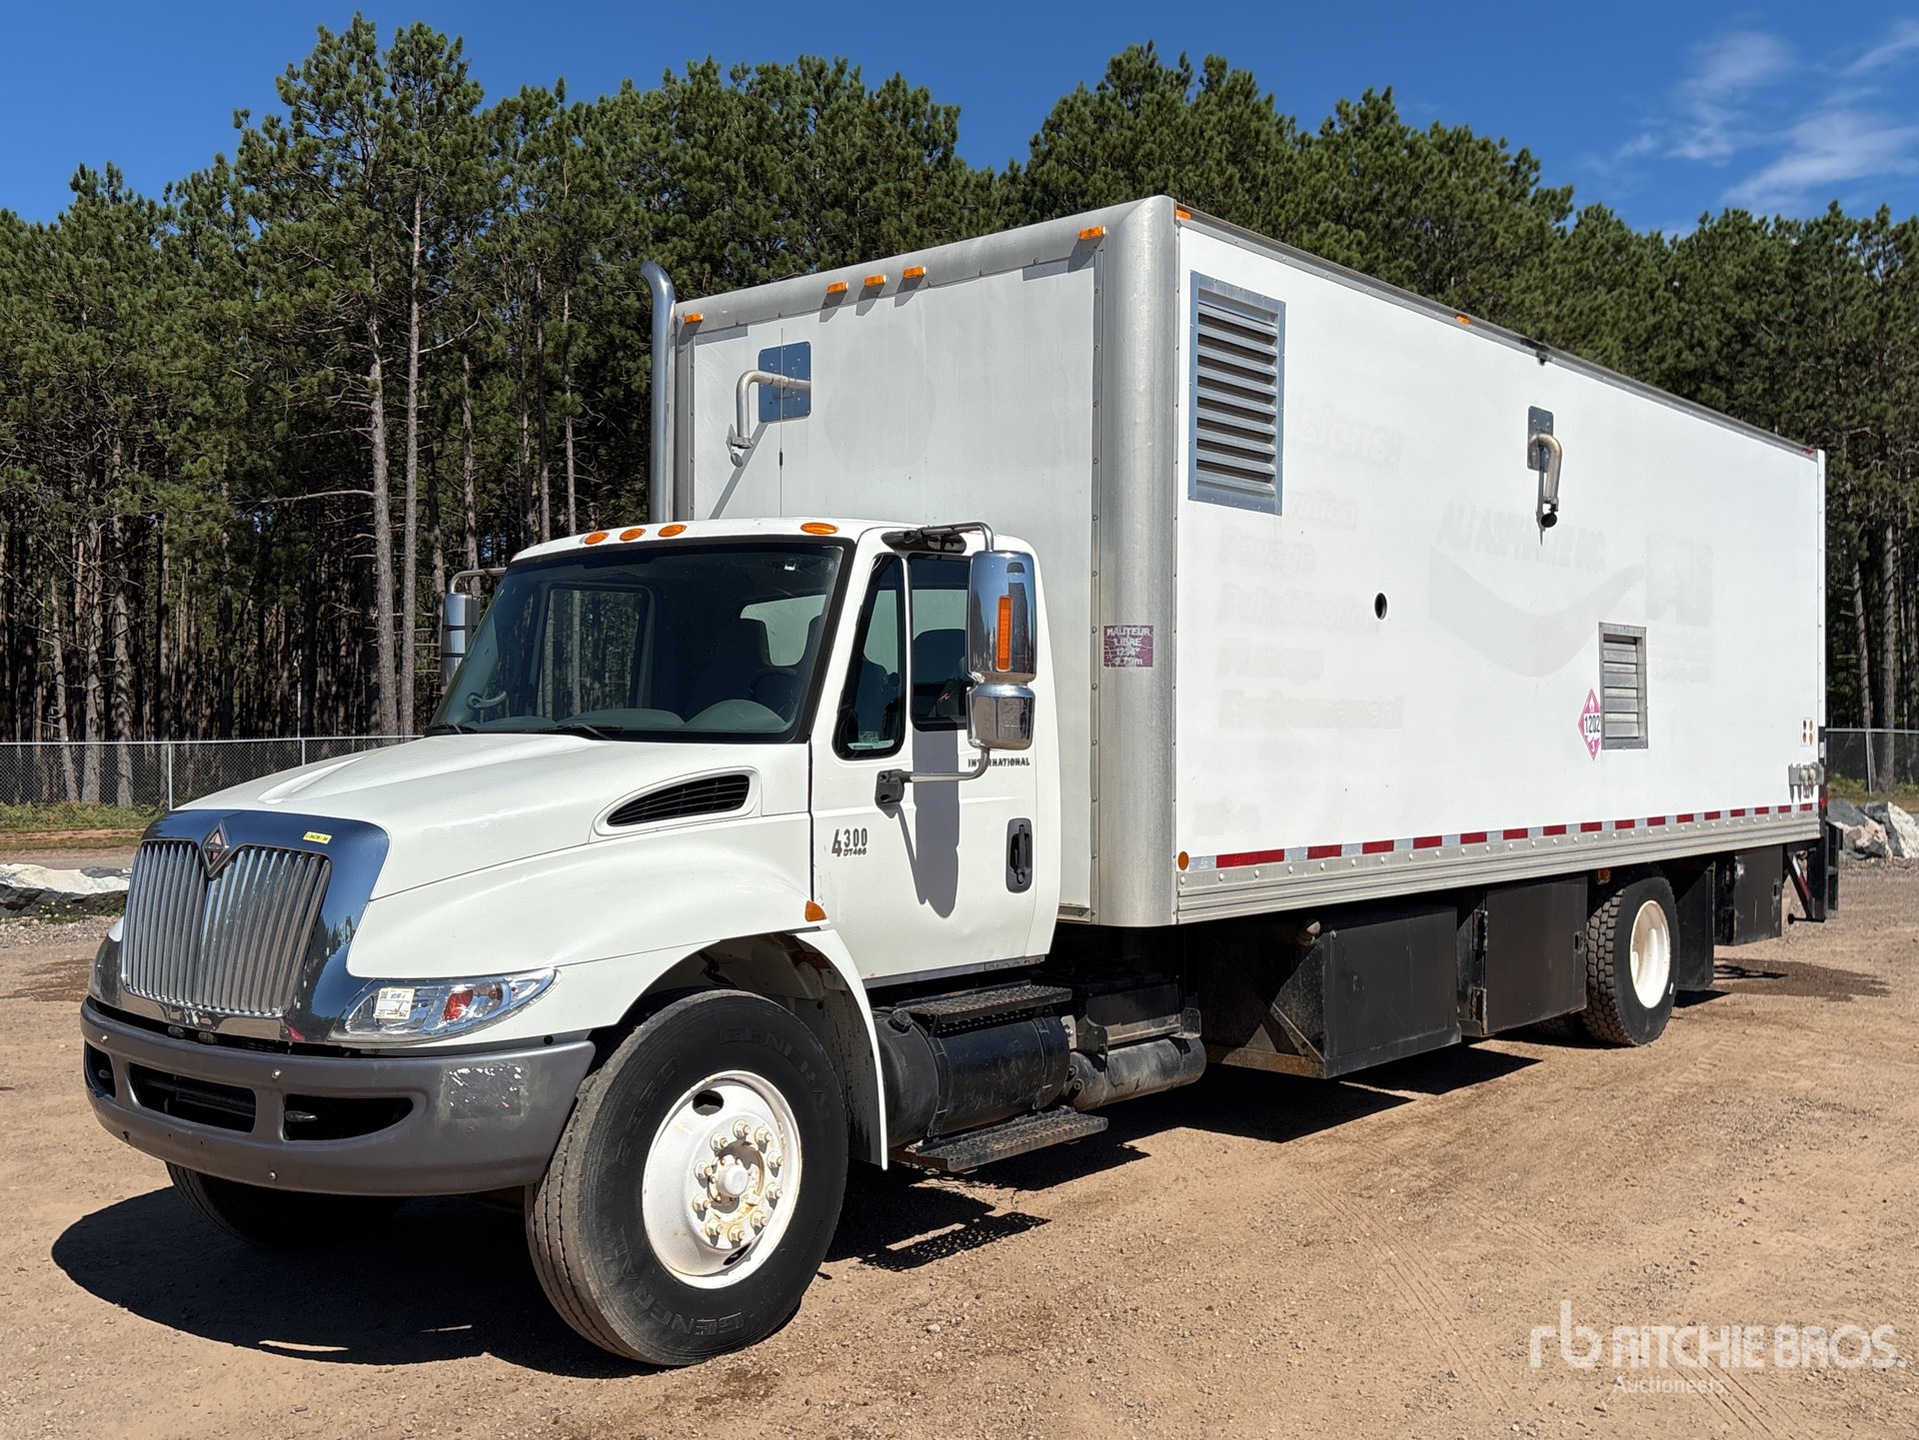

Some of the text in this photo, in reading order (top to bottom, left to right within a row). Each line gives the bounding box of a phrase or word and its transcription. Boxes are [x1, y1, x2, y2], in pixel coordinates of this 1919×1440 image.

[1585, 714, 1600, 733] 1202
[968, 757, 1030, 767] INTRNATIONAL
[831, 828, 868, 857] 4300
